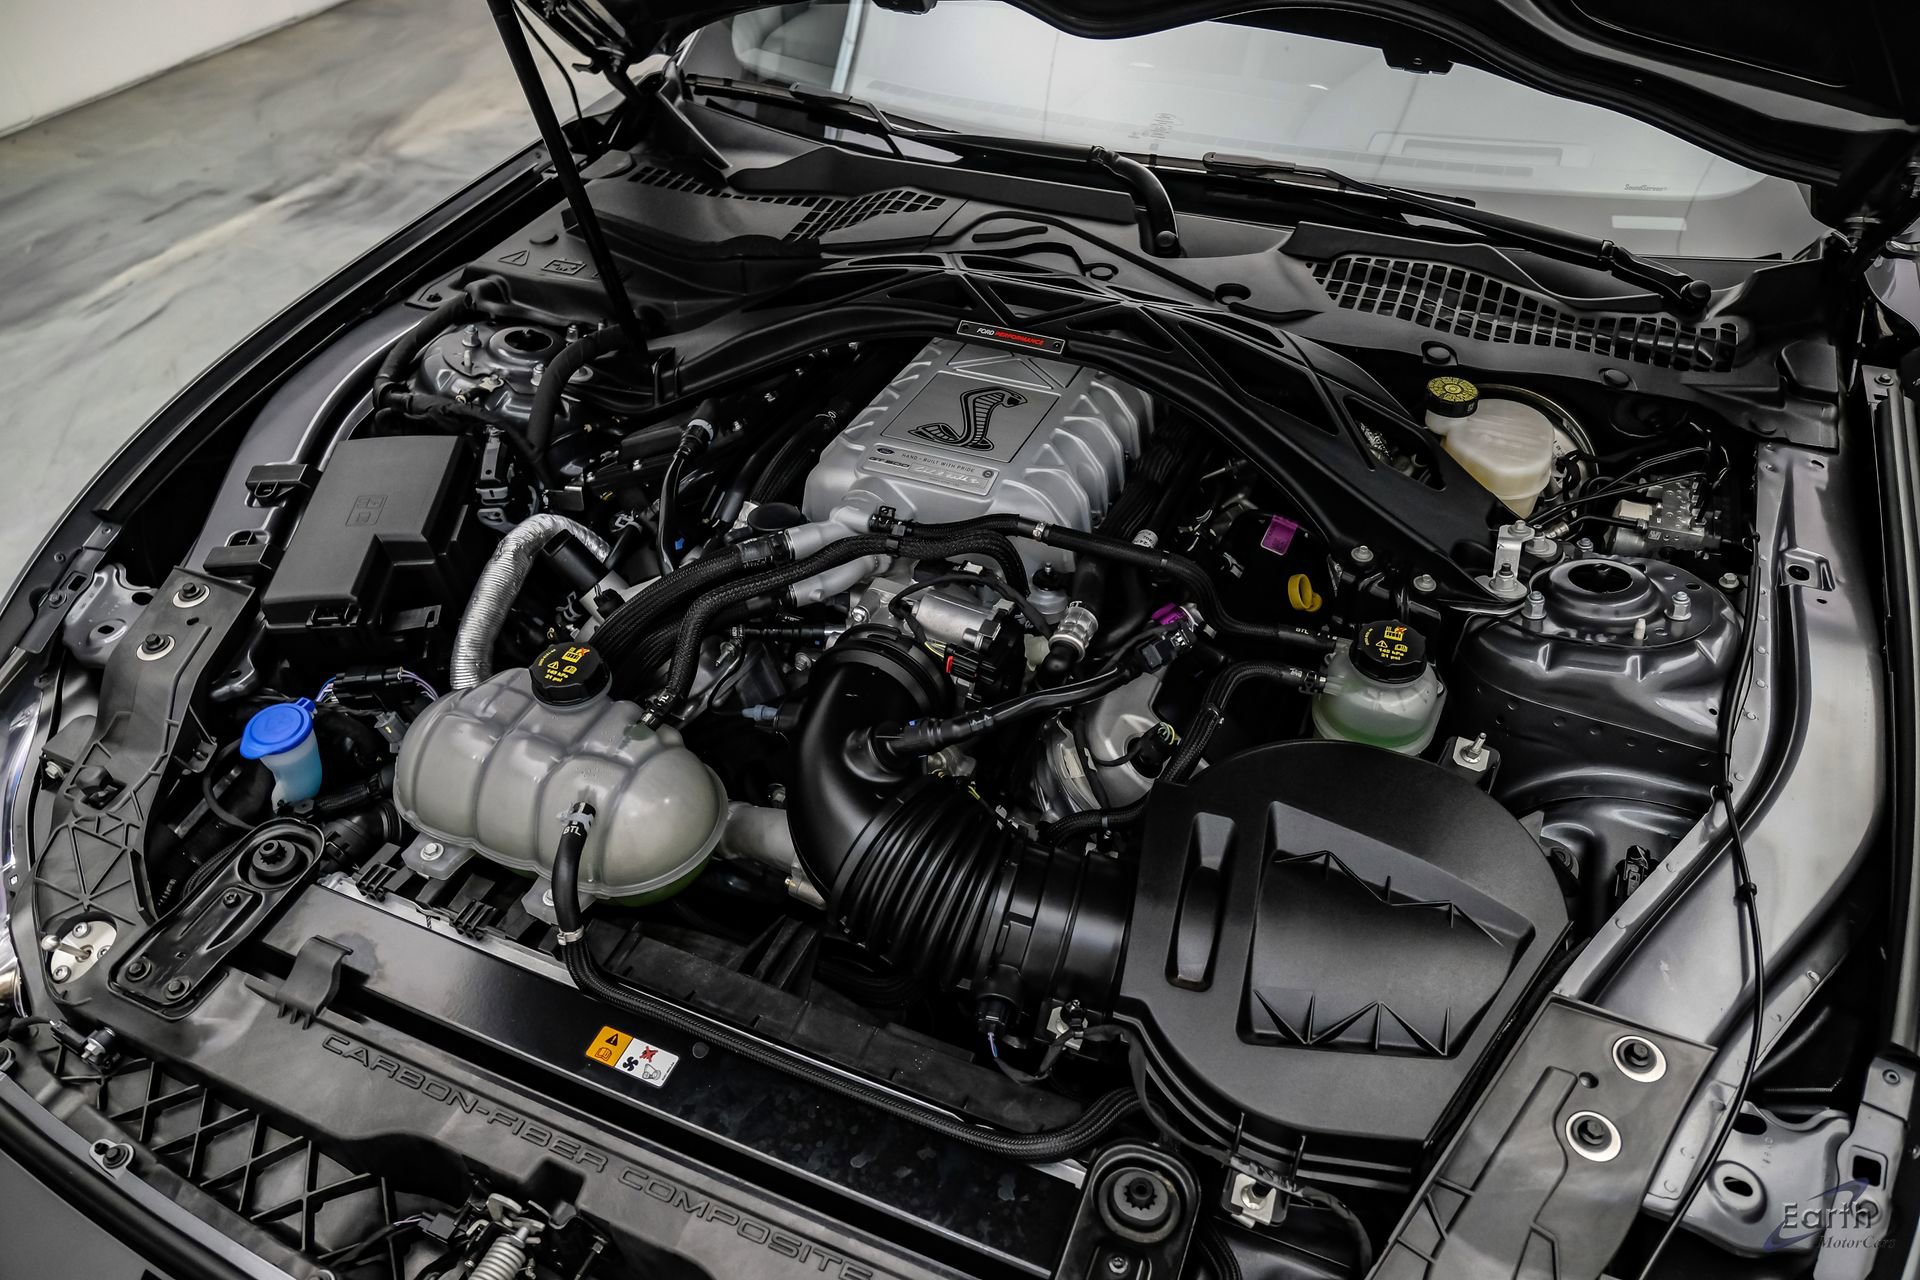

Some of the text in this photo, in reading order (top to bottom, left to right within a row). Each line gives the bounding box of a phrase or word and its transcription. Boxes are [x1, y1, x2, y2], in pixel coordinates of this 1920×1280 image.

[976, 327, 1045, 346] FORD PERFORMANCE
[940, 461, 956, 469] WITH
[956, 465, 976, 473] PRIDE
[322, 1033, 875, 1280] CARBON-FIBER COMPOSITE
